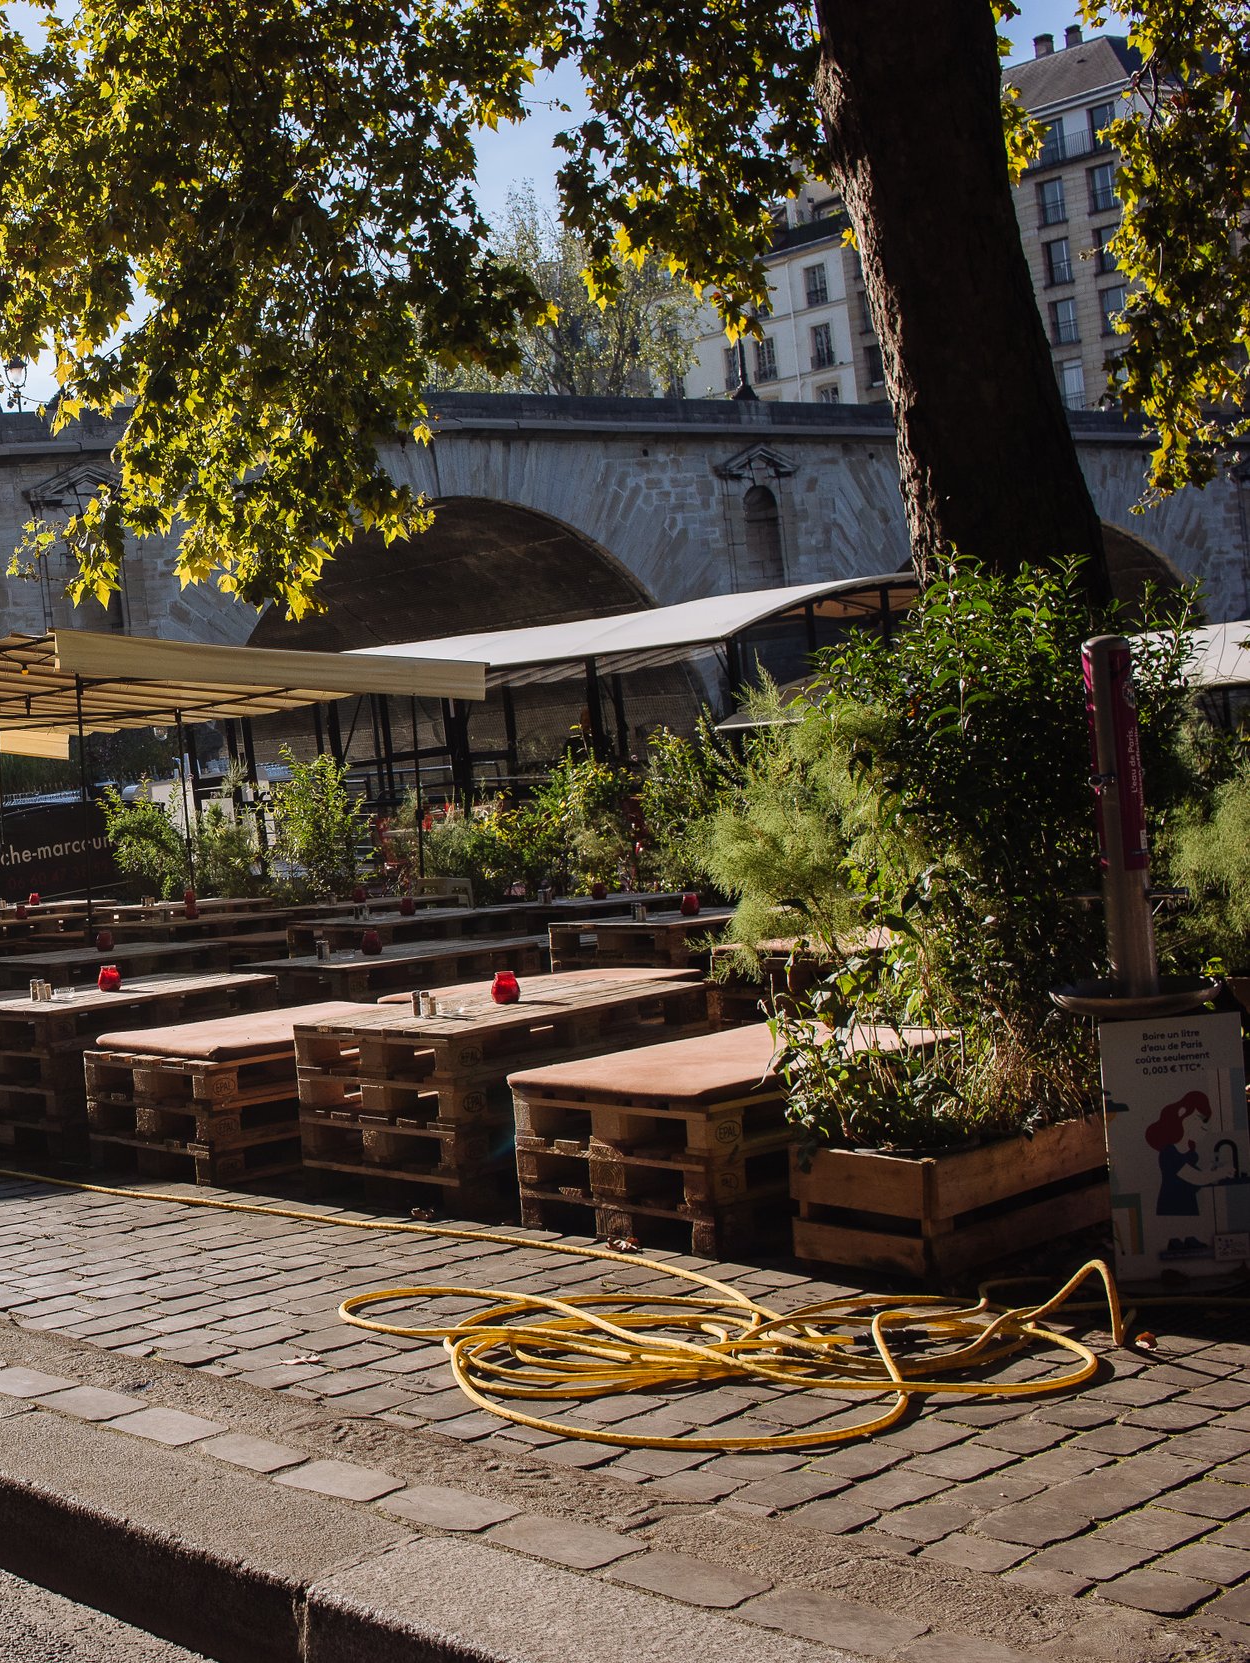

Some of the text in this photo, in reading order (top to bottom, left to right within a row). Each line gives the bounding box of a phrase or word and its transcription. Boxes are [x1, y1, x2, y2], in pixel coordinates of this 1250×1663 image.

[1128, 755, 1136, 768] de
[1142, 1032, 1165, 1041] Boire
[1181, 1029, 1199, 1037] litre
[1141, 1040, 1203, 1052] d'eau de Paris
[1135, 1052, 1210, 1064] coûte seulement
[1142, 1065, 1168, 1076] 0,003
[215, 1080, 232, 1092] EPAL
[718, 1127, 738, 1139] EPAL
